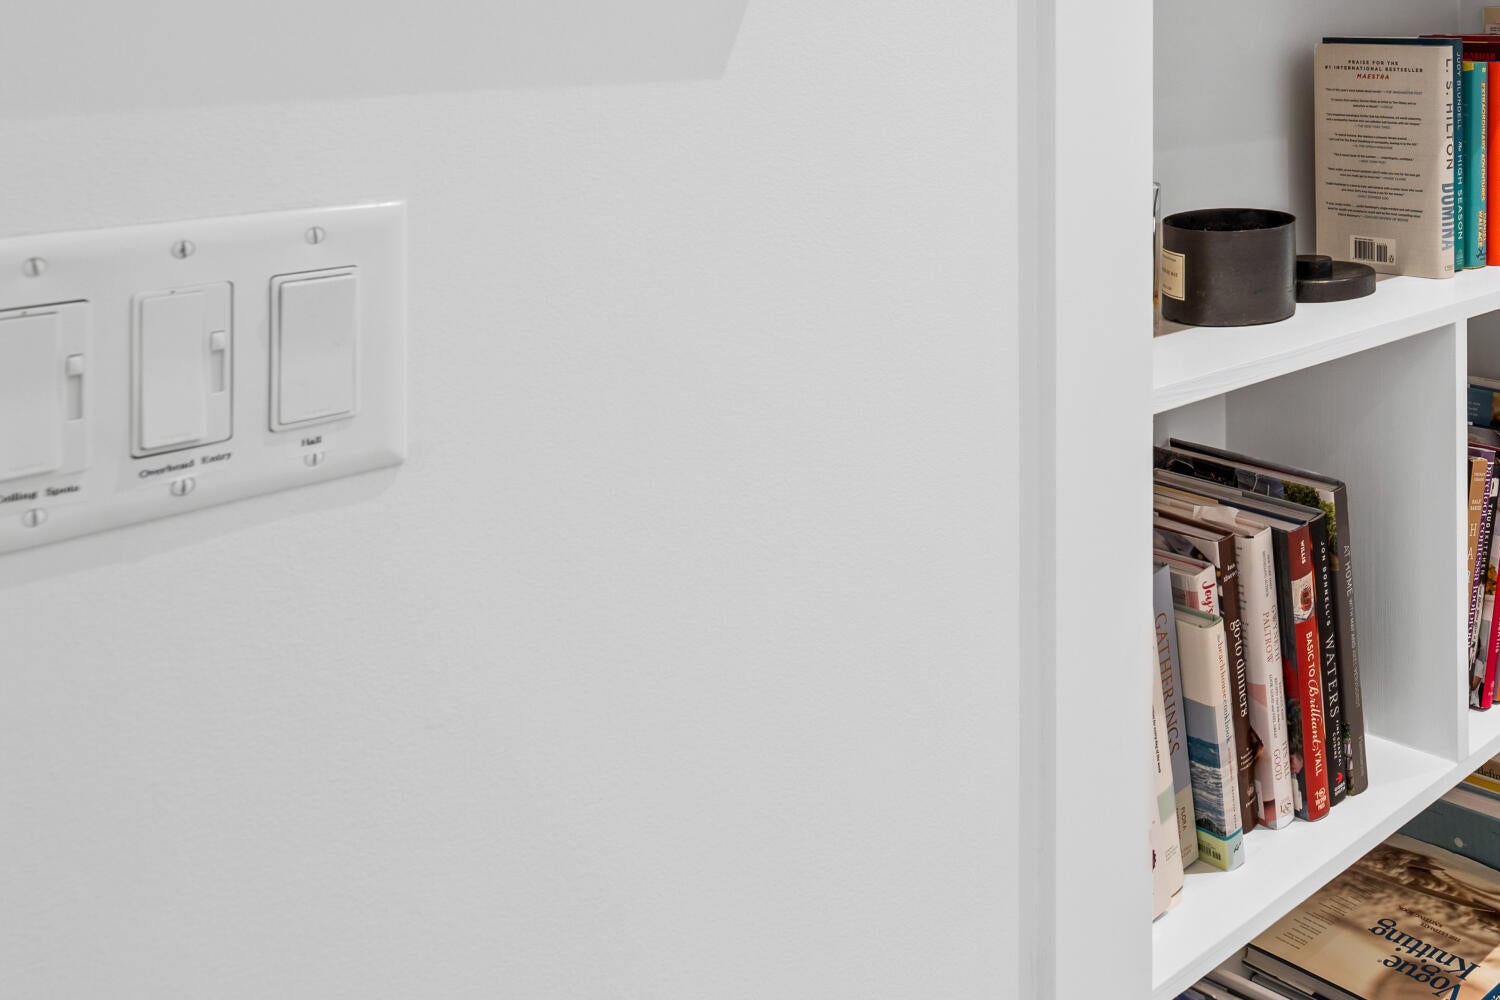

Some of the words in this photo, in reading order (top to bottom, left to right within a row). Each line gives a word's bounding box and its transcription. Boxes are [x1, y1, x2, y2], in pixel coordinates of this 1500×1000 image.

[1446, 103, 1454, 170] HILTON
[1442, 183, 1454, 252] DOMINA
[201, 451, 233, 466] Entry
[301, 434, 323, 448] Hall
[1480, 460, 1494, 515] barefoot
[1486, 502, 1494, 526] THUG
[1299, 540, 1307, 565] WILLIS
[1343, 544, 1352, 559] AT
[1473, 518, 1488, 582] contessa
[1480, 536, 1490, 576] KITCHEN
[1322, 566, 1332, 627] BONNELL'S
[1344, 561, 1354, 597] HOME
[1230, 618, 1246, 658] go-to
[1262, 610, 1275, 664] PALTROW
[1304, 630, 1316, 661] BASIC
[1154, 611, 1181, 757] GATHERINGS
[1234, 660, 1250, 718] dinners
[1308, 662, 1316, 678] TO
[1324, 632, 1340, 719] WATERS
[1273, 748, 1283, 781] GOOD
[1312, 750, 1324, 777] Y'ALL
[1368, 918, 1481, 982] Knitting
[1381, 954, 1461, 1000] Vogue
